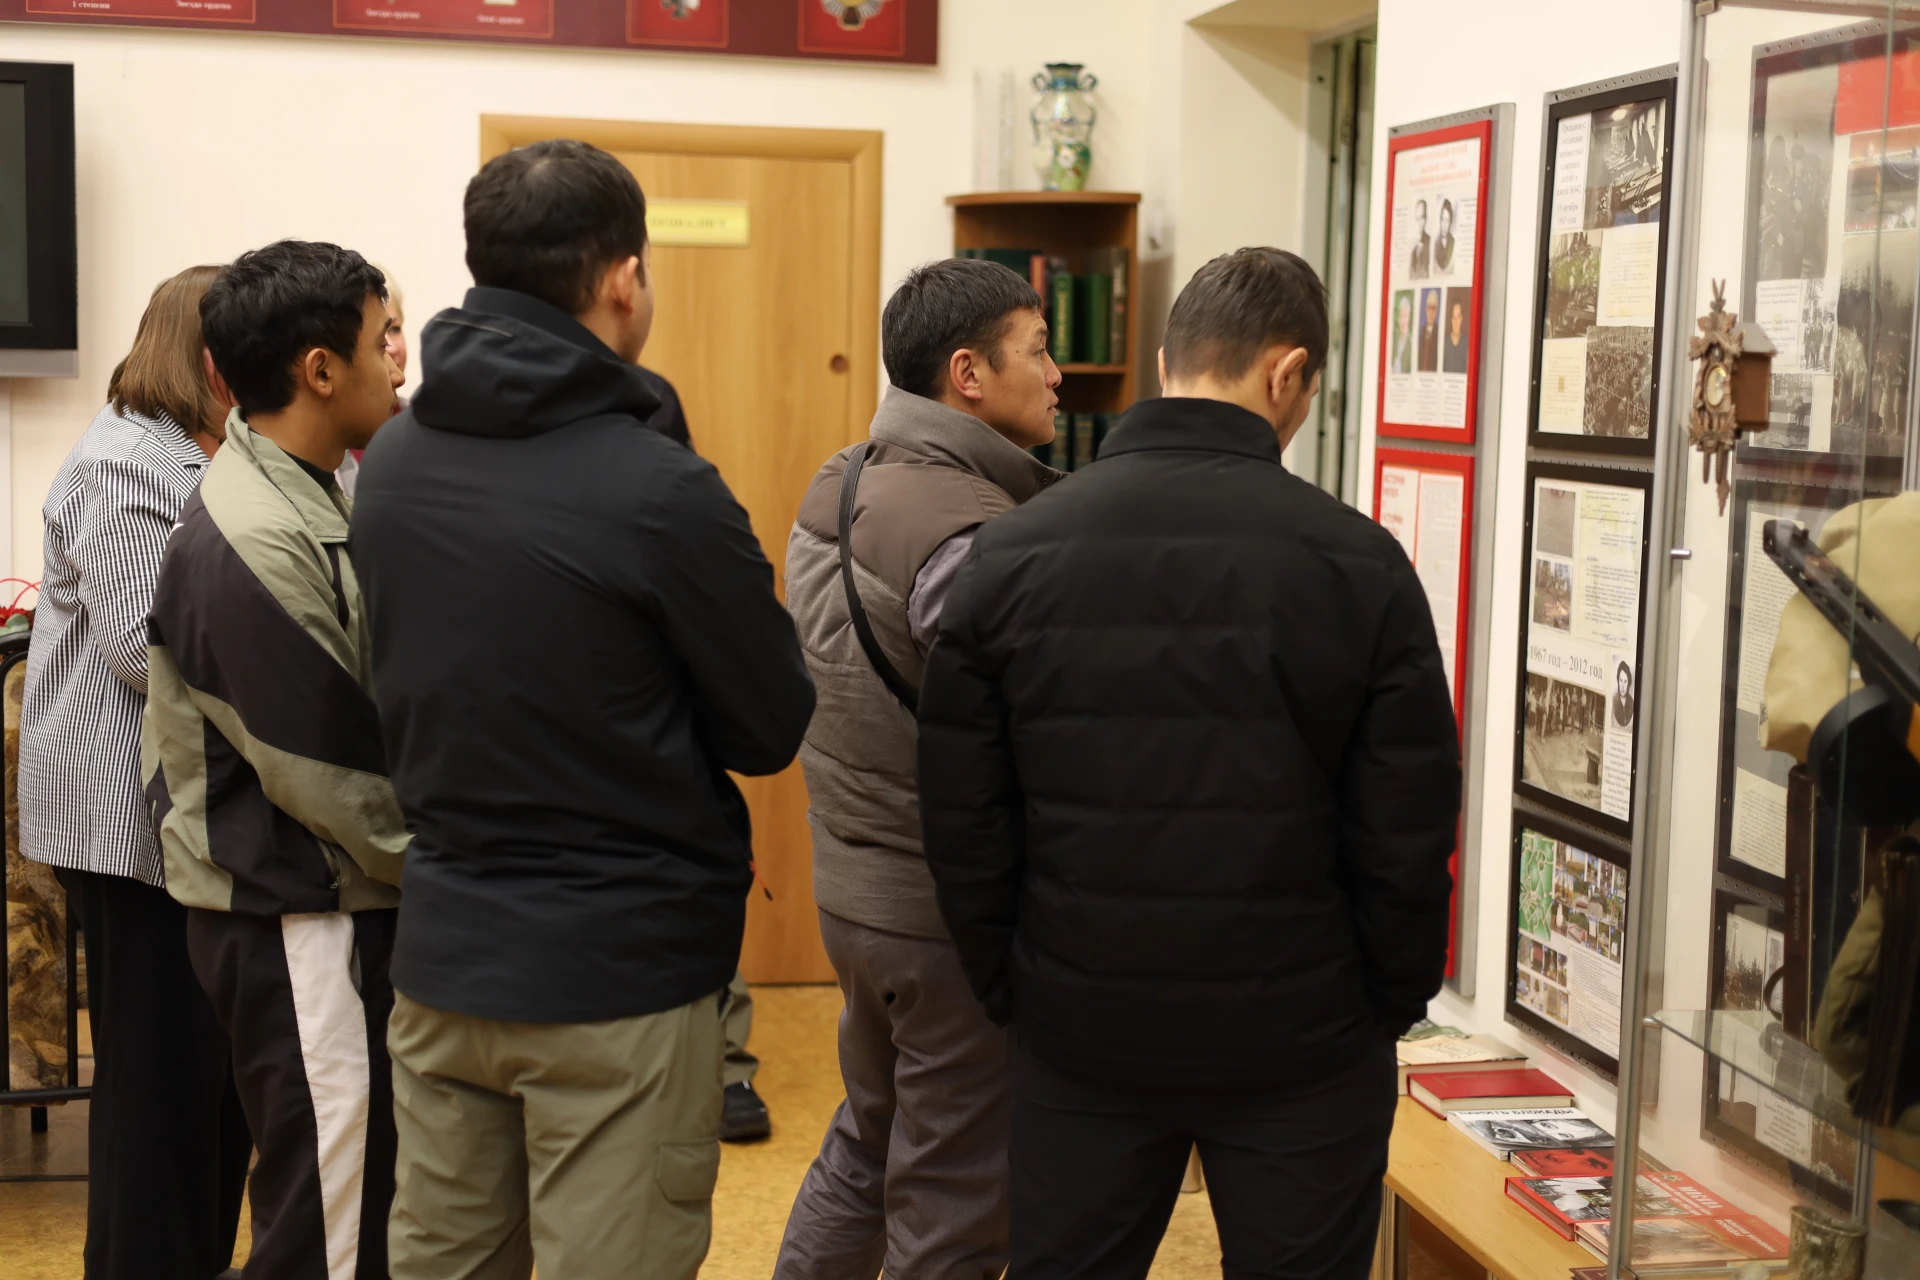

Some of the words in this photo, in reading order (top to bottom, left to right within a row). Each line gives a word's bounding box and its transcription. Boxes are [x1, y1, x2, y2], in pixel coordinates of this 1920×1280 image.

[1530, 645, 1547, 663] 1967
[1548, 654, 1561, 669] год
[1569, 655, 1588, 675] 2012
[1589, 664, 1603, 680] год
